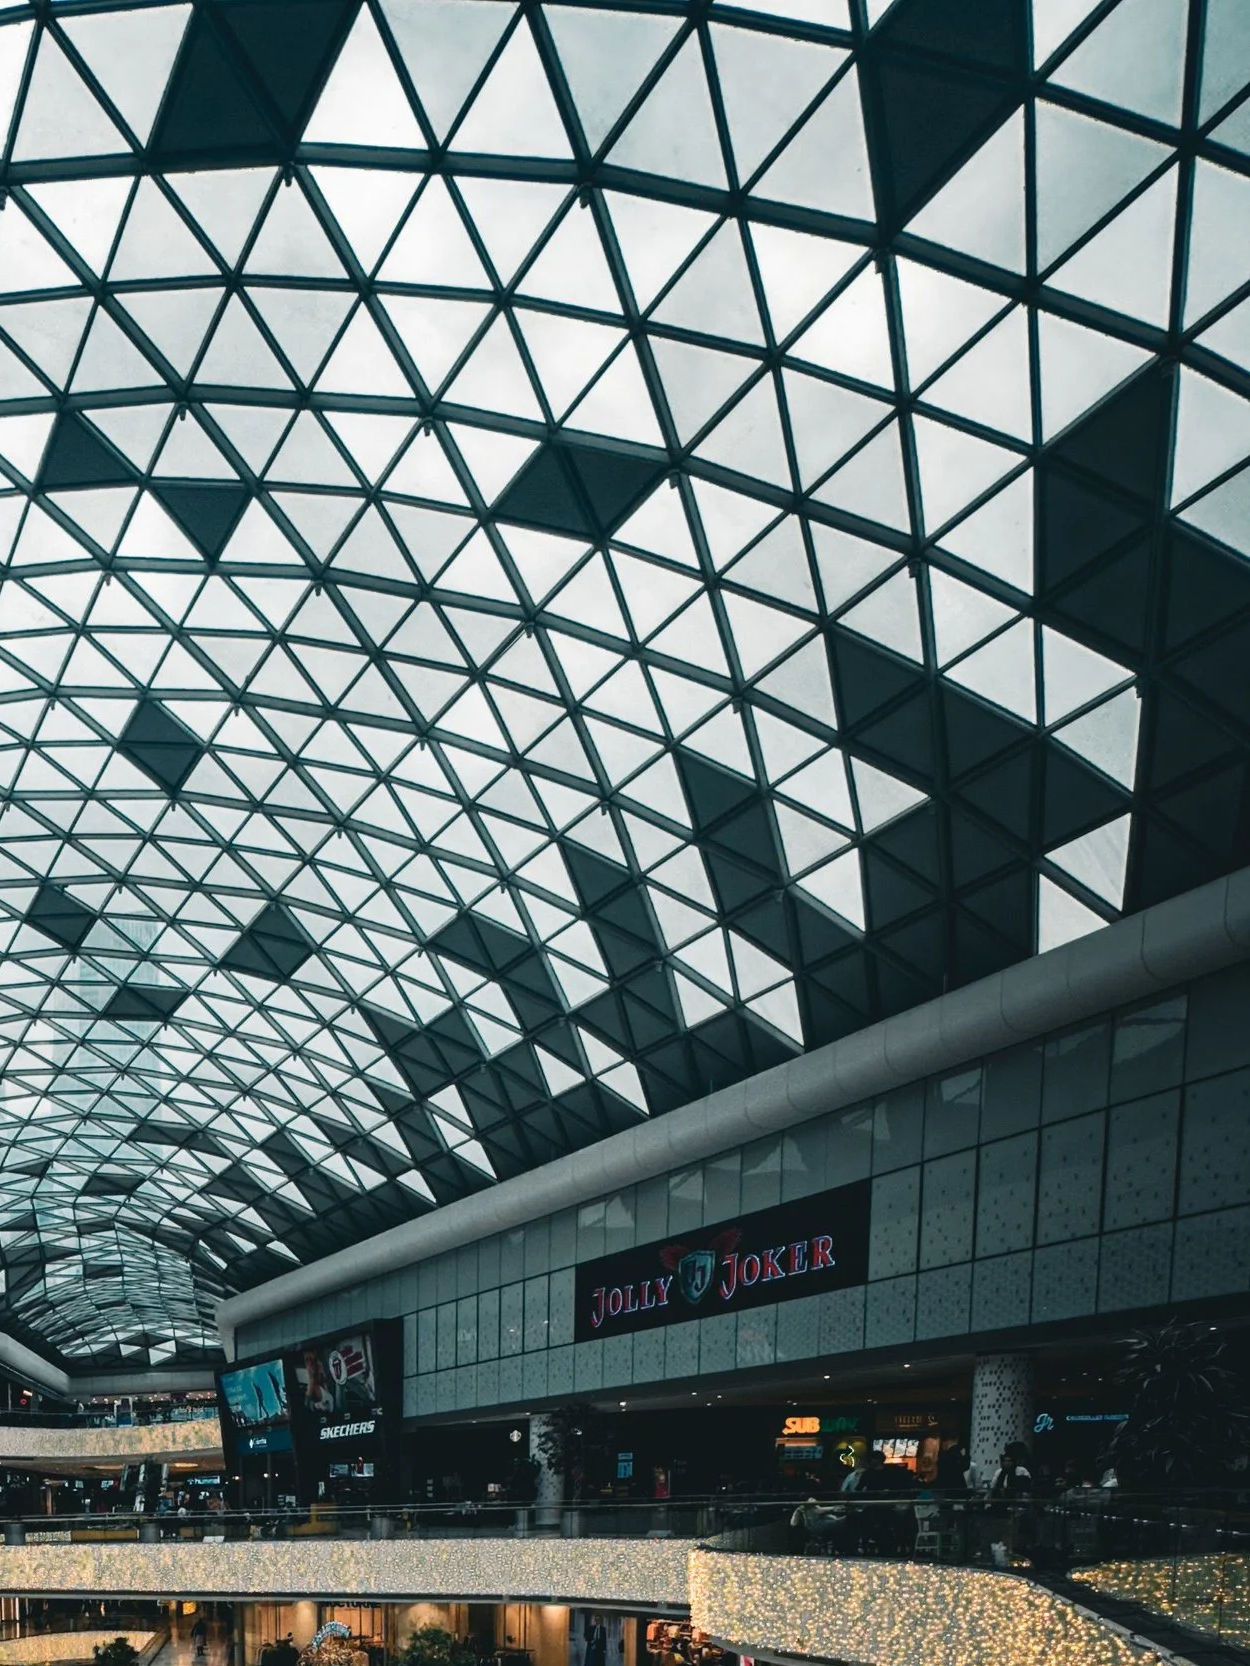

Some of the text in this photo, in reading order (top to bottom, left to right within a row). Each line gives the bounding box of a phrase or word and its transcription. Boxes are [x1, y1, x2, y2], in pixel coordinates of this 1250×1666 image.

[590, 1235, 836, 1328] JOLLY JOKER
[319, 1420, 376, 1440] SKECHERS
